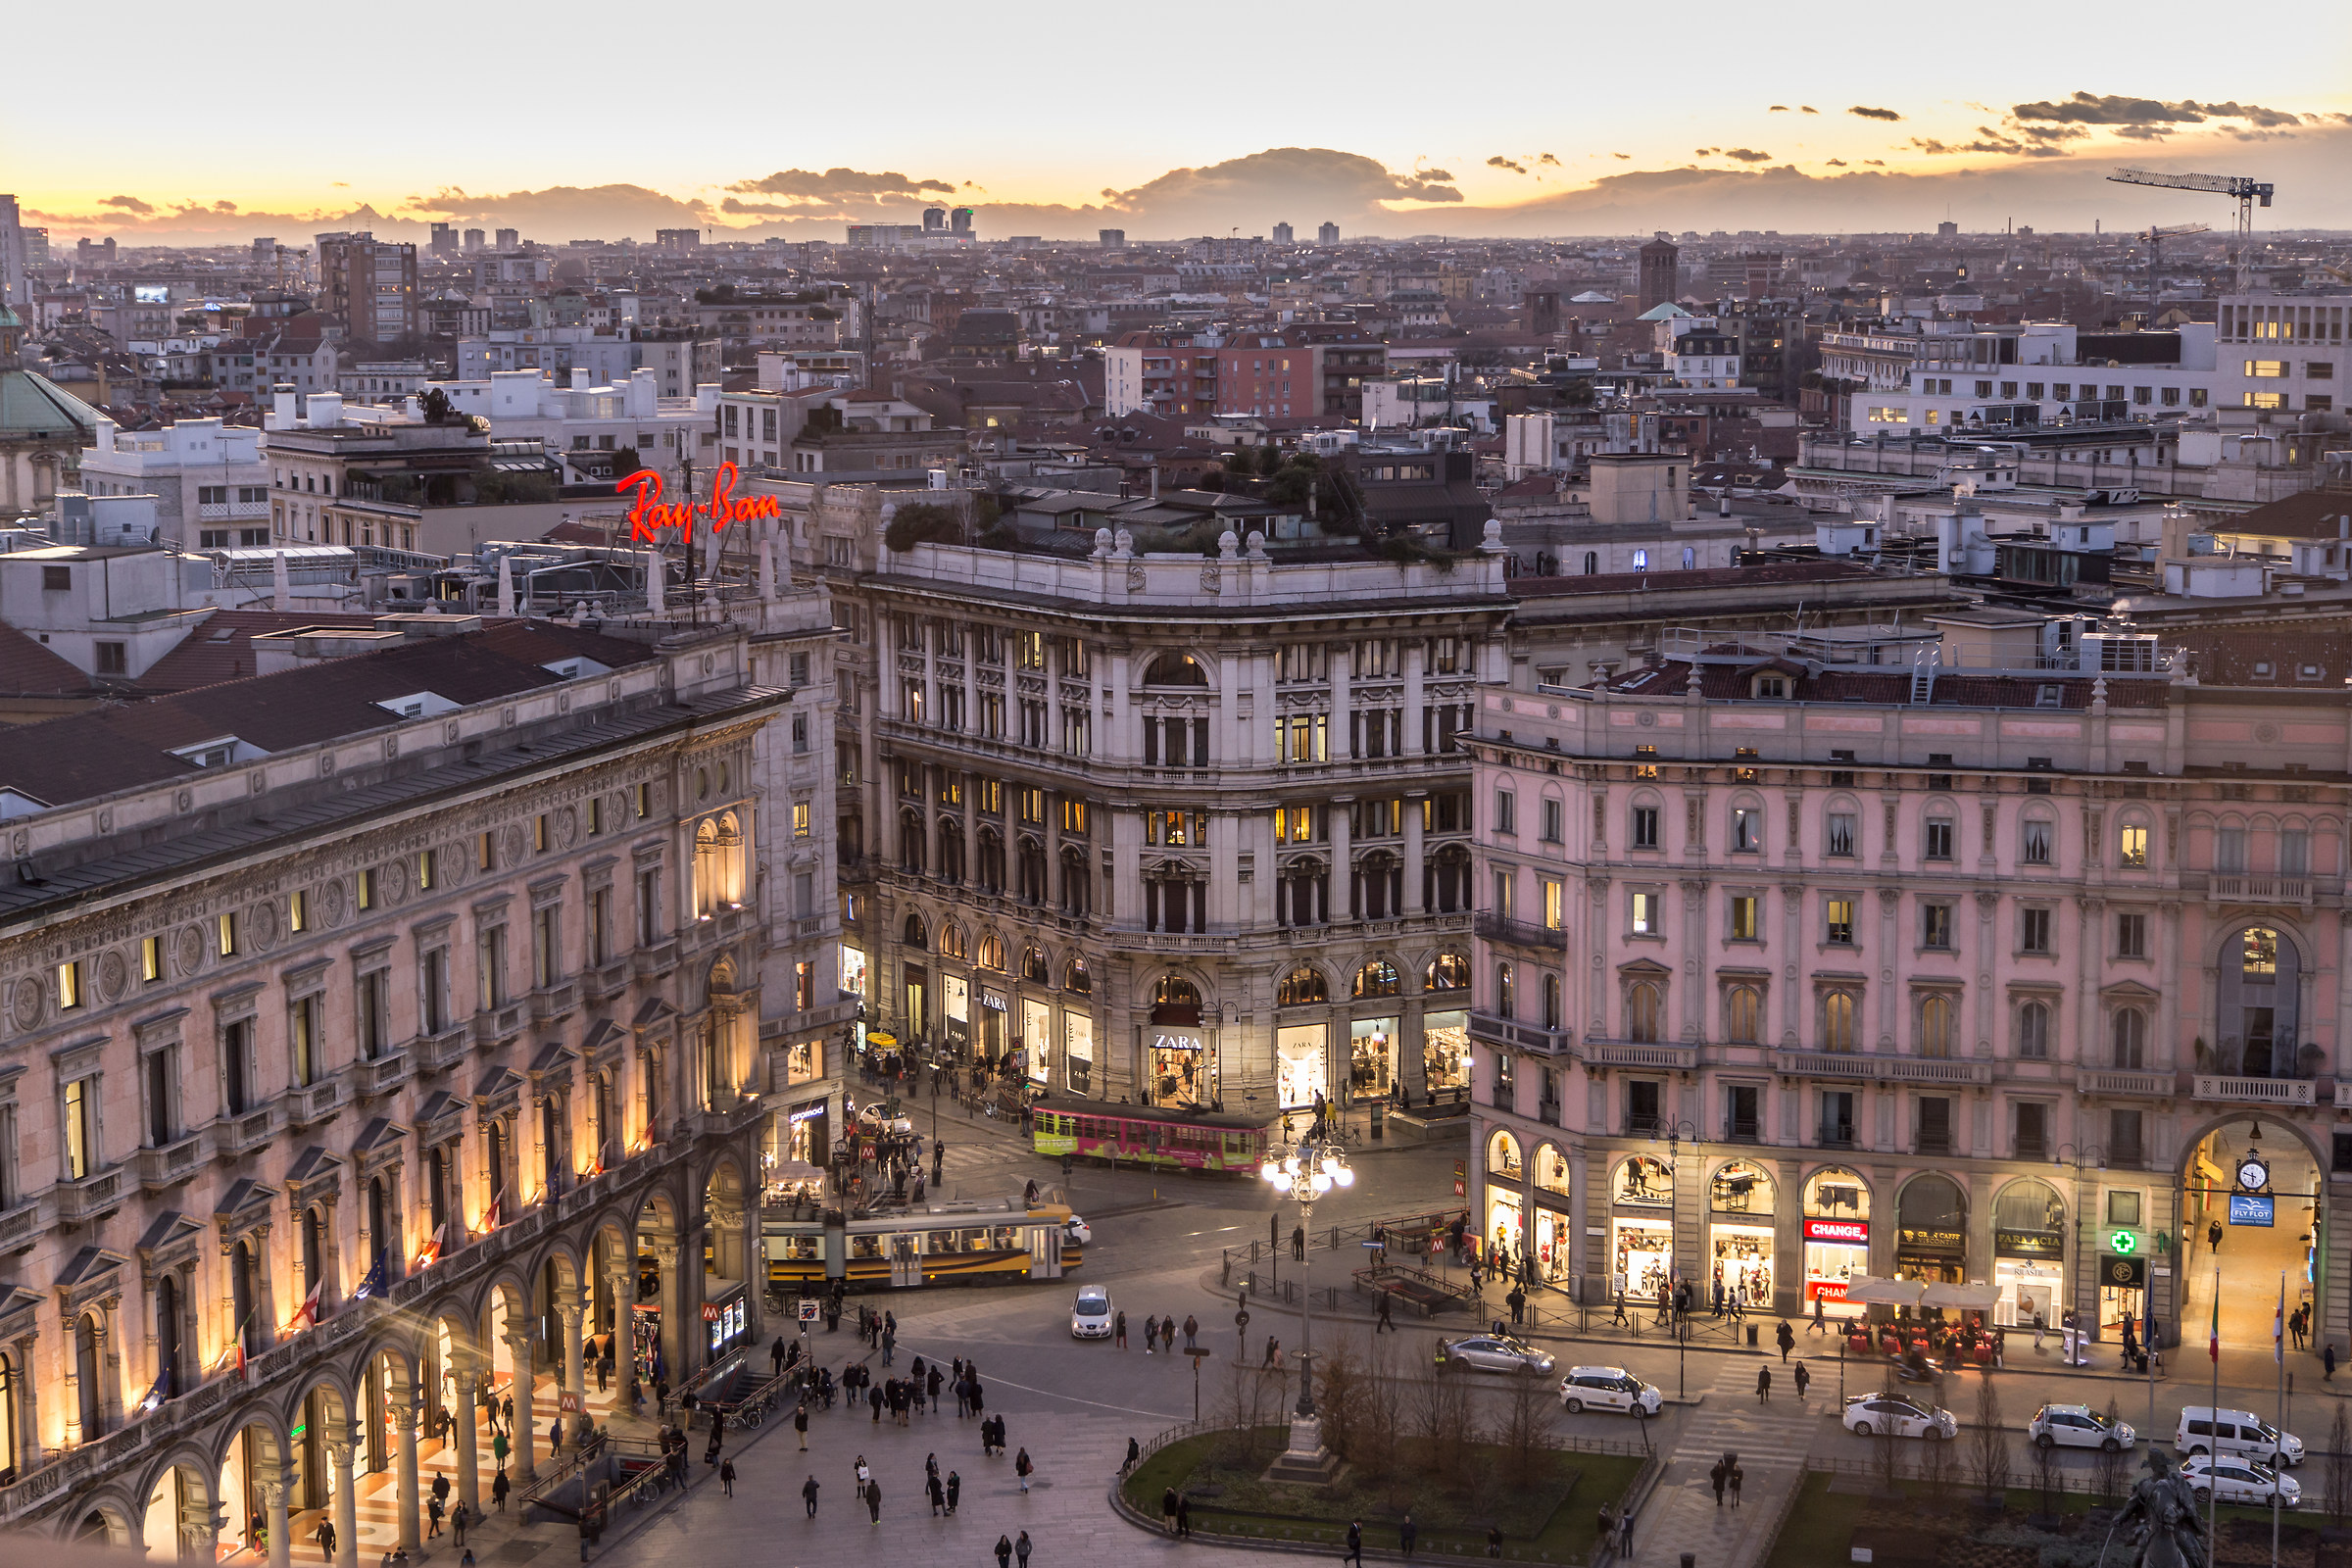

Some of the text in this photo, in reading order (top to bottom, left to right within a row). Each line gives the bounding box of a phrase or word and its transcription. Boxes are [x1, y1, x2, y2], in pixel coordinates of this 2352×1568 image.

[983, 993, 1007, 1012] ZARA
[951, 1030, 966, 1041] ZARA
[1155, 1034, 1202, 1050] ZARA
[790, 1105, 824, 1124] promod
[862, 1147, 875, 1156] M
[1454, 1183, 1464, 1195] M
[1811, 1223, 1861, 1237] CHANGE
[1432, 1240, 1444, 1251] M
[1817, 1286, 1847, 1298] CHAN
[704, 1306, 718, 1319] M
[562, 1396, 577, 1409] M
